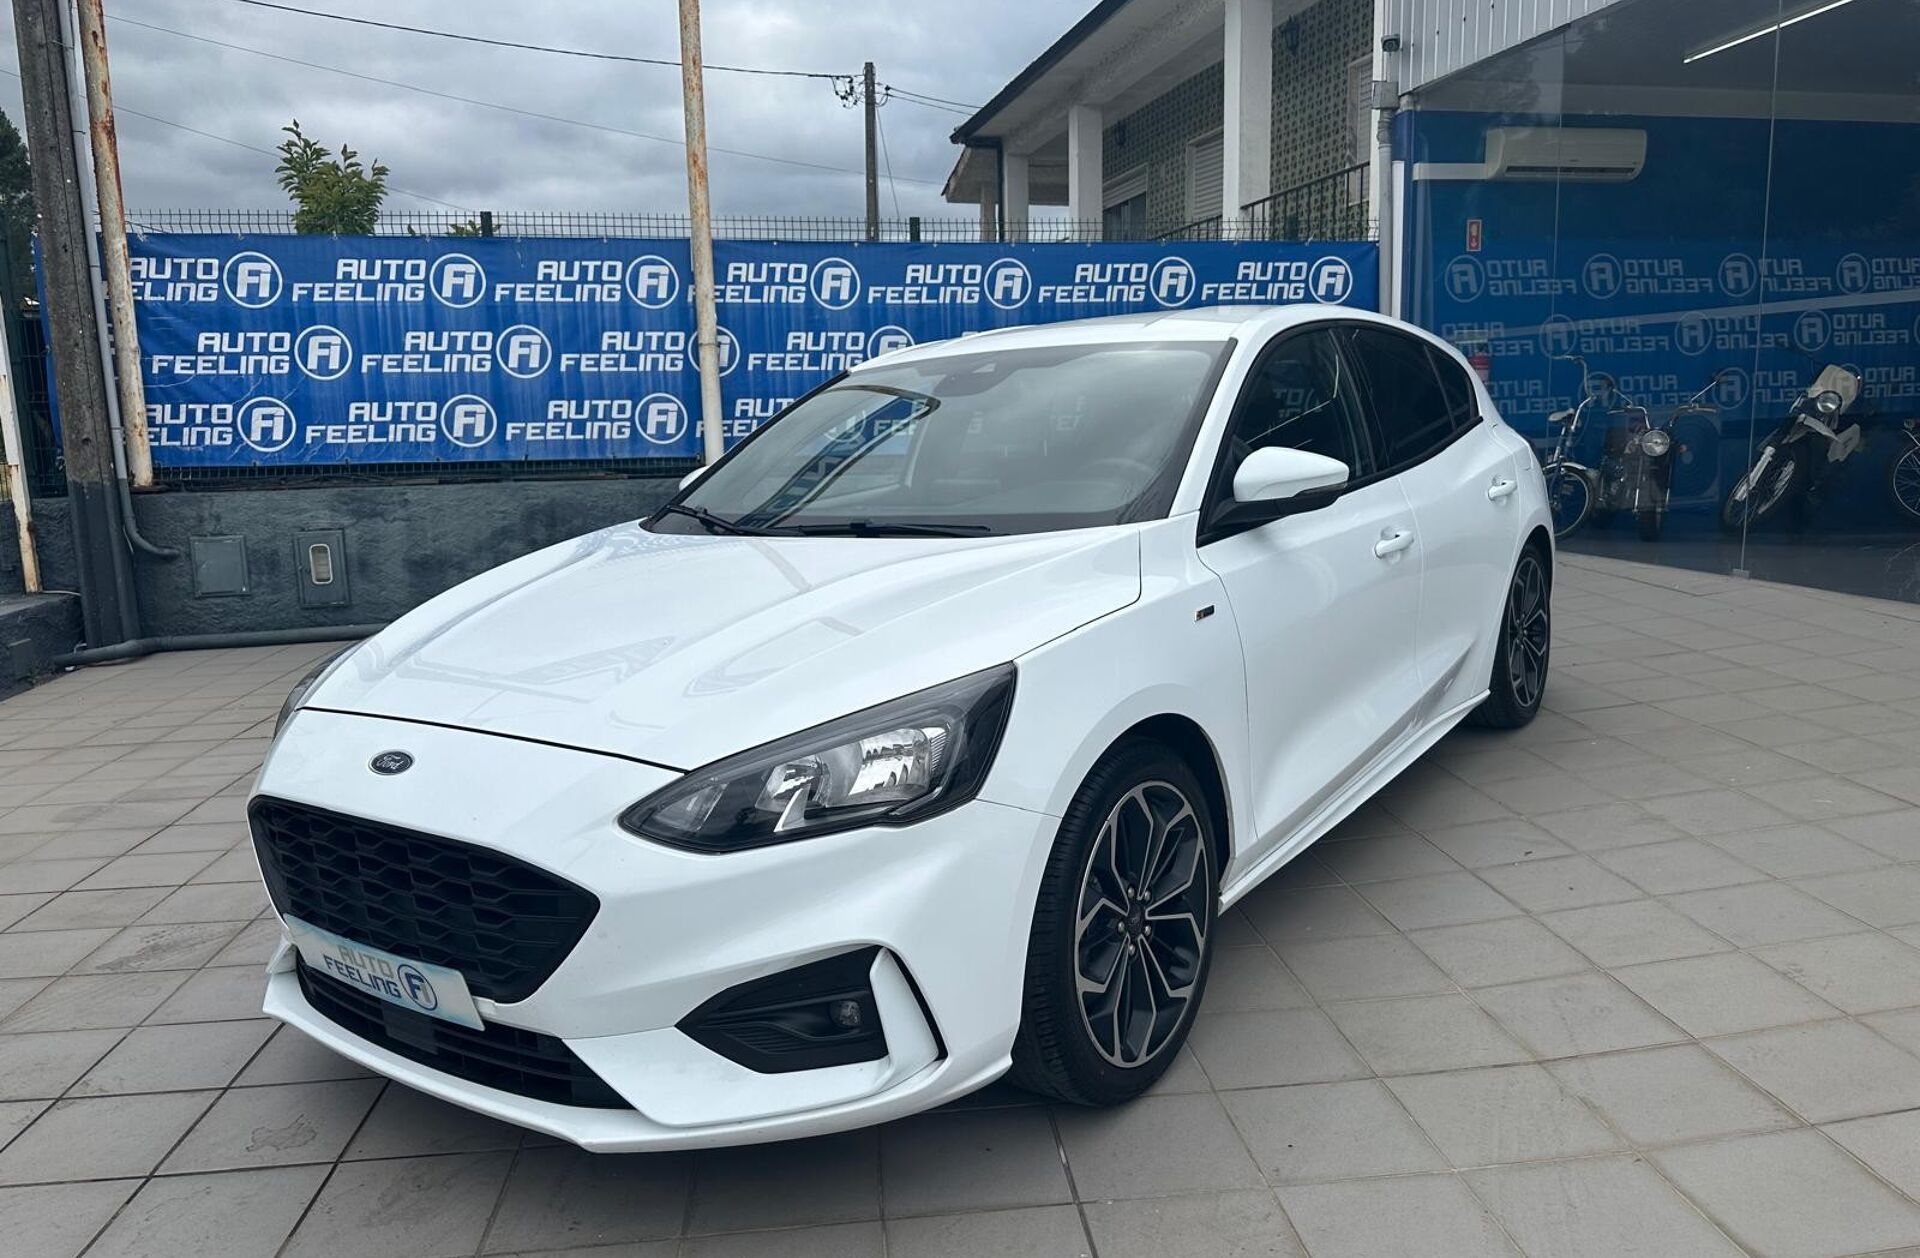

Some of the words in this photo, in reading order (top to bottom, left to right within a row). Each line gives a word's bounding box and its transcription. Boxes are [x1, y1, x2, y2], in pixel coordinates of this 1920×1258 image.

[336, 259, 426, 280] AUTO
[537, 260, 623, 281] AUTO
[727, 262, 808, 283] AUTO
[905, 264, 982, 285] AUTO
[1075, 263, 1148, 283] AUTO
[1237, 261, 1307, 281] AUTO
[292, 282, 425, 302] FEELING
[495, 283, 622, 302] FEELING
[868, 286, 980, 304] FEELING
[1038, 285, 1146, 303] FEELING
[1201, 282, 1305, 301] FEELING
[198, 332, 291, 353] AUTO
[404, 331, 493, 351] AUTO
[602, 332, 685, 351] AUTO
[786, 332, 866, 351] AUTO
[152, 354, 290, 375] FEELING
[361, 353, 492, 373] FEELING
[560, 354, 684, 372] FEELING
[349, 402, 437, 422] AUTO
[547, 400, 631, 419] AUTO
[735, 398, 796, 417] AUT
[305, 424, 437, 444] FEELING
[505, 422, 630, 441] FEELING
[338, 946, 395, 979] AUTO
[323, 955, 401, 998] FEELING
